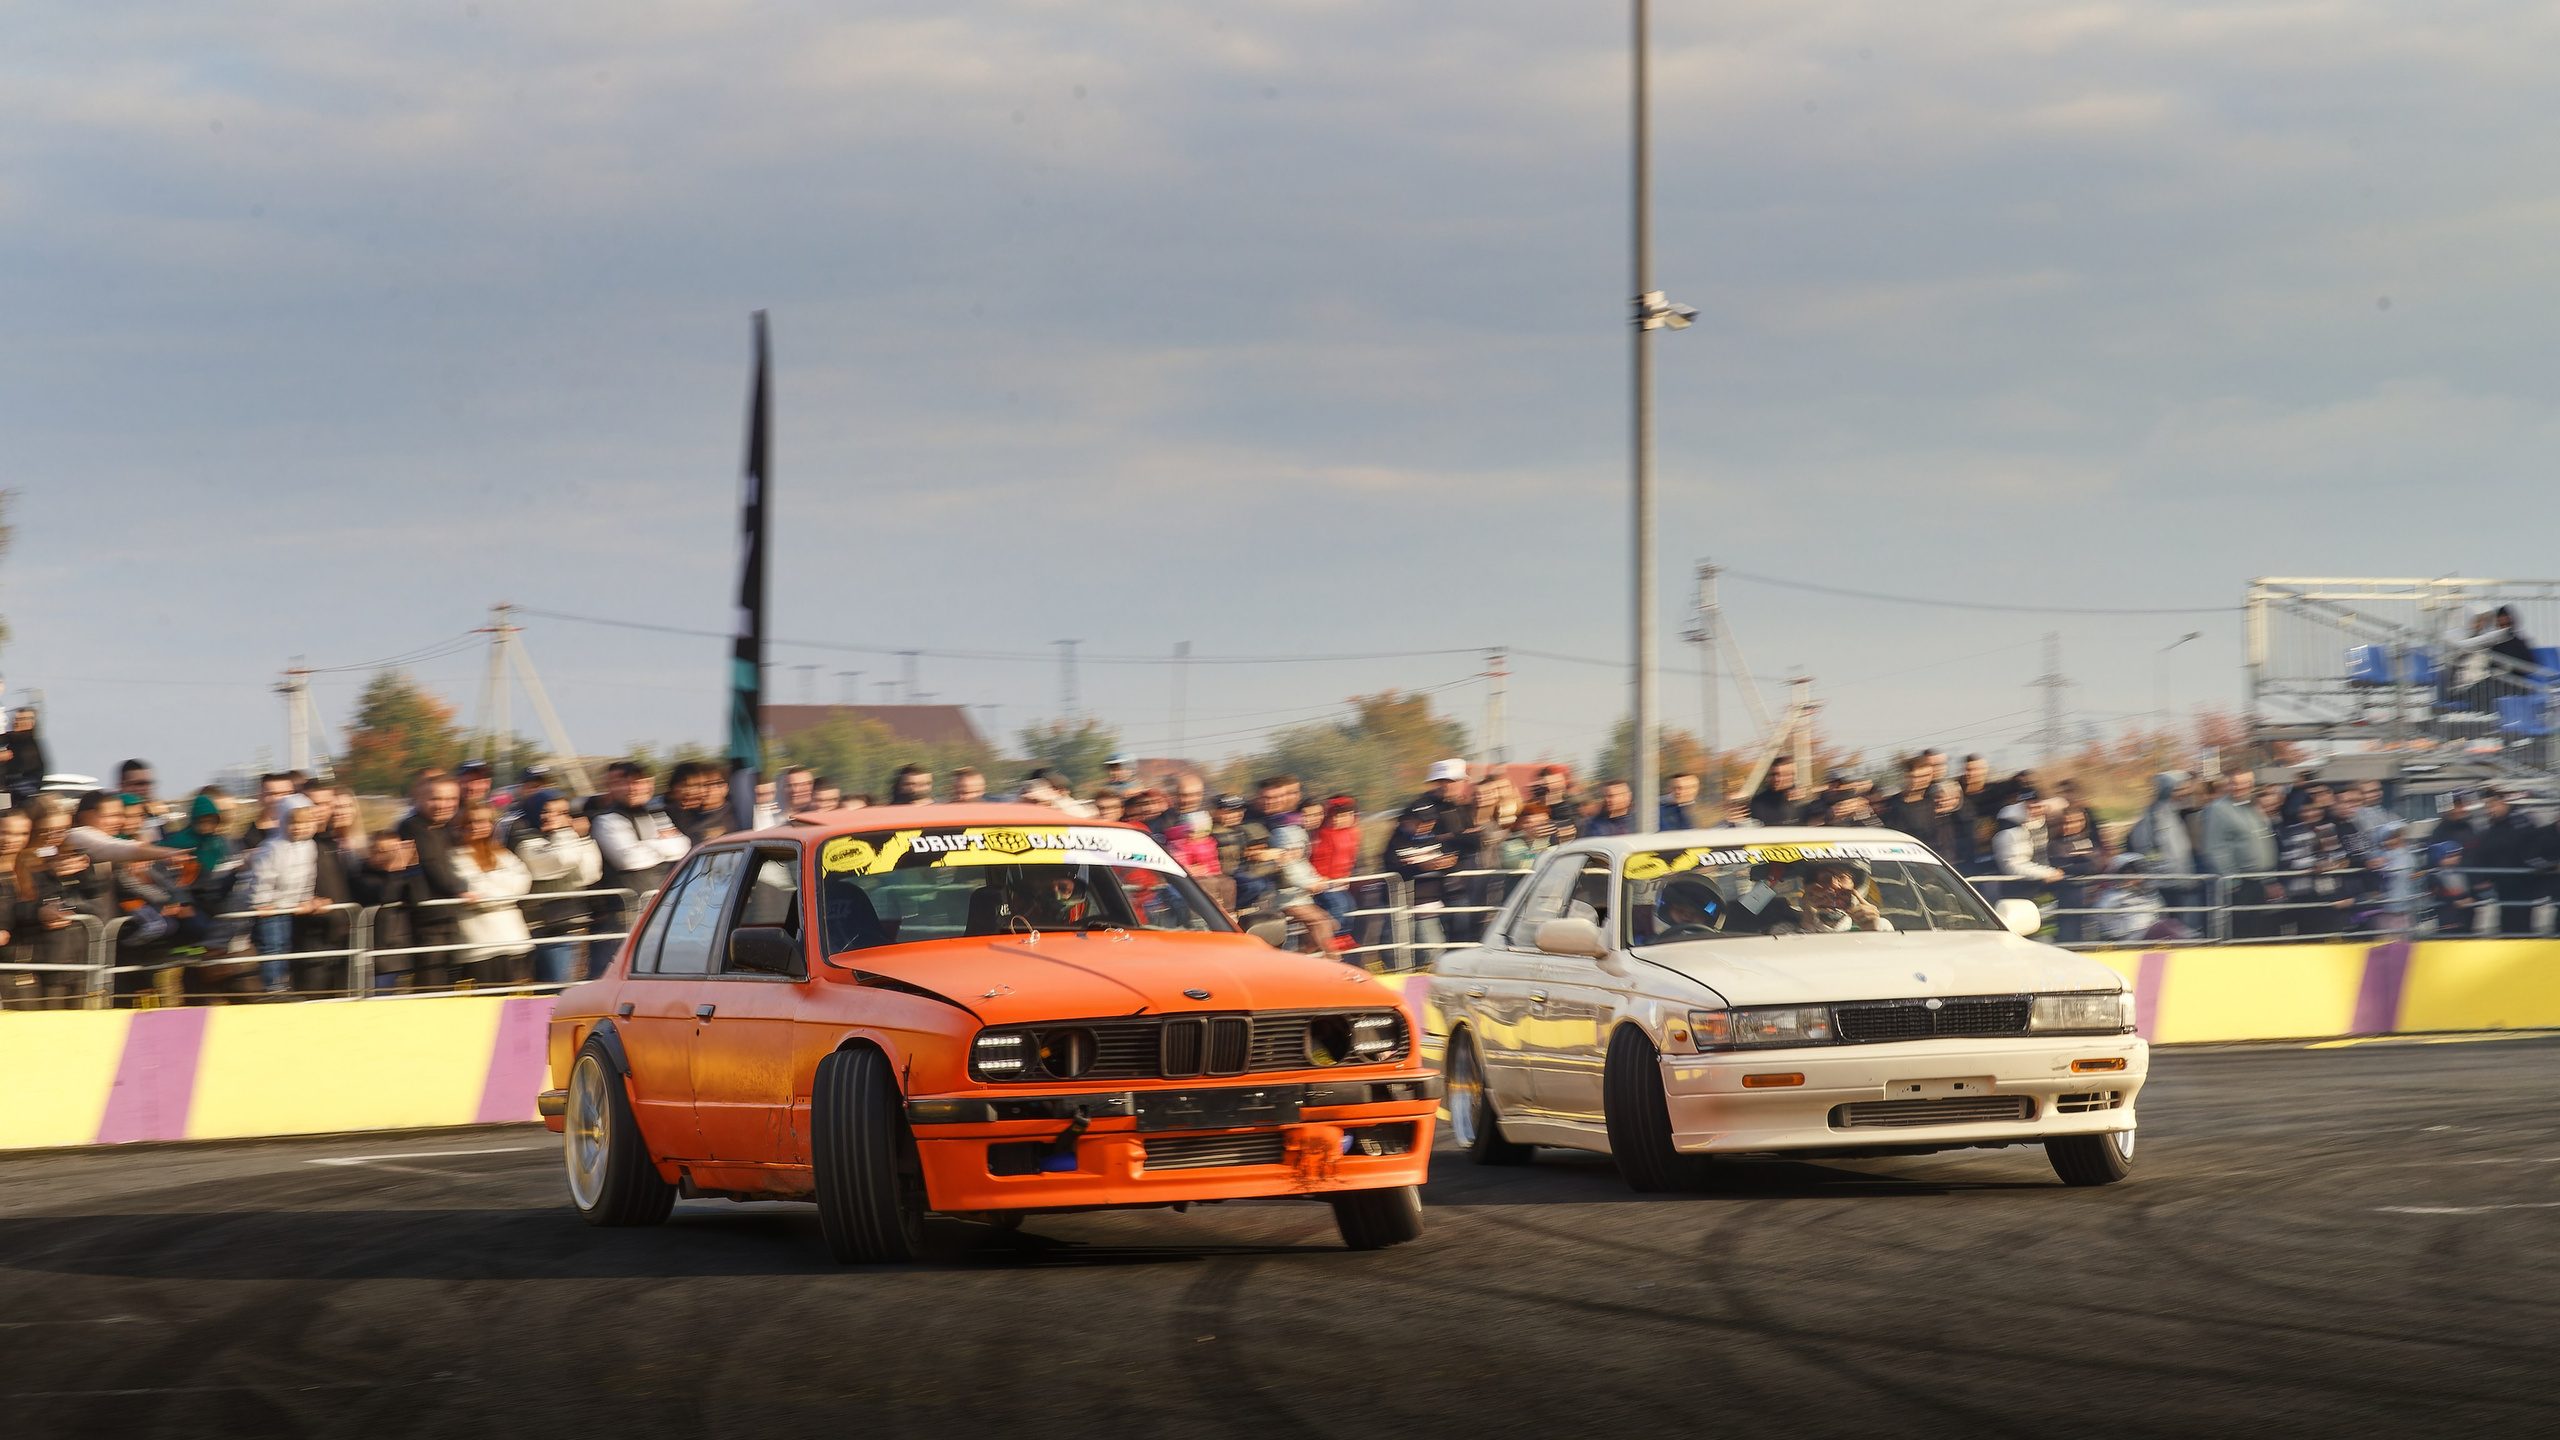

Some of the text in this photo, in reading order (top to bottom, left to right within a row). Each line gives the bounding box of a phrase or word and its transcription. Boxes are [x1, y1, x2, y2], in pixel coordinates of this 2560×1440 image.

[908, 833, 1112, 853] DRIFT GAMES
[1697, 849, 1764, 867] DRIFT
